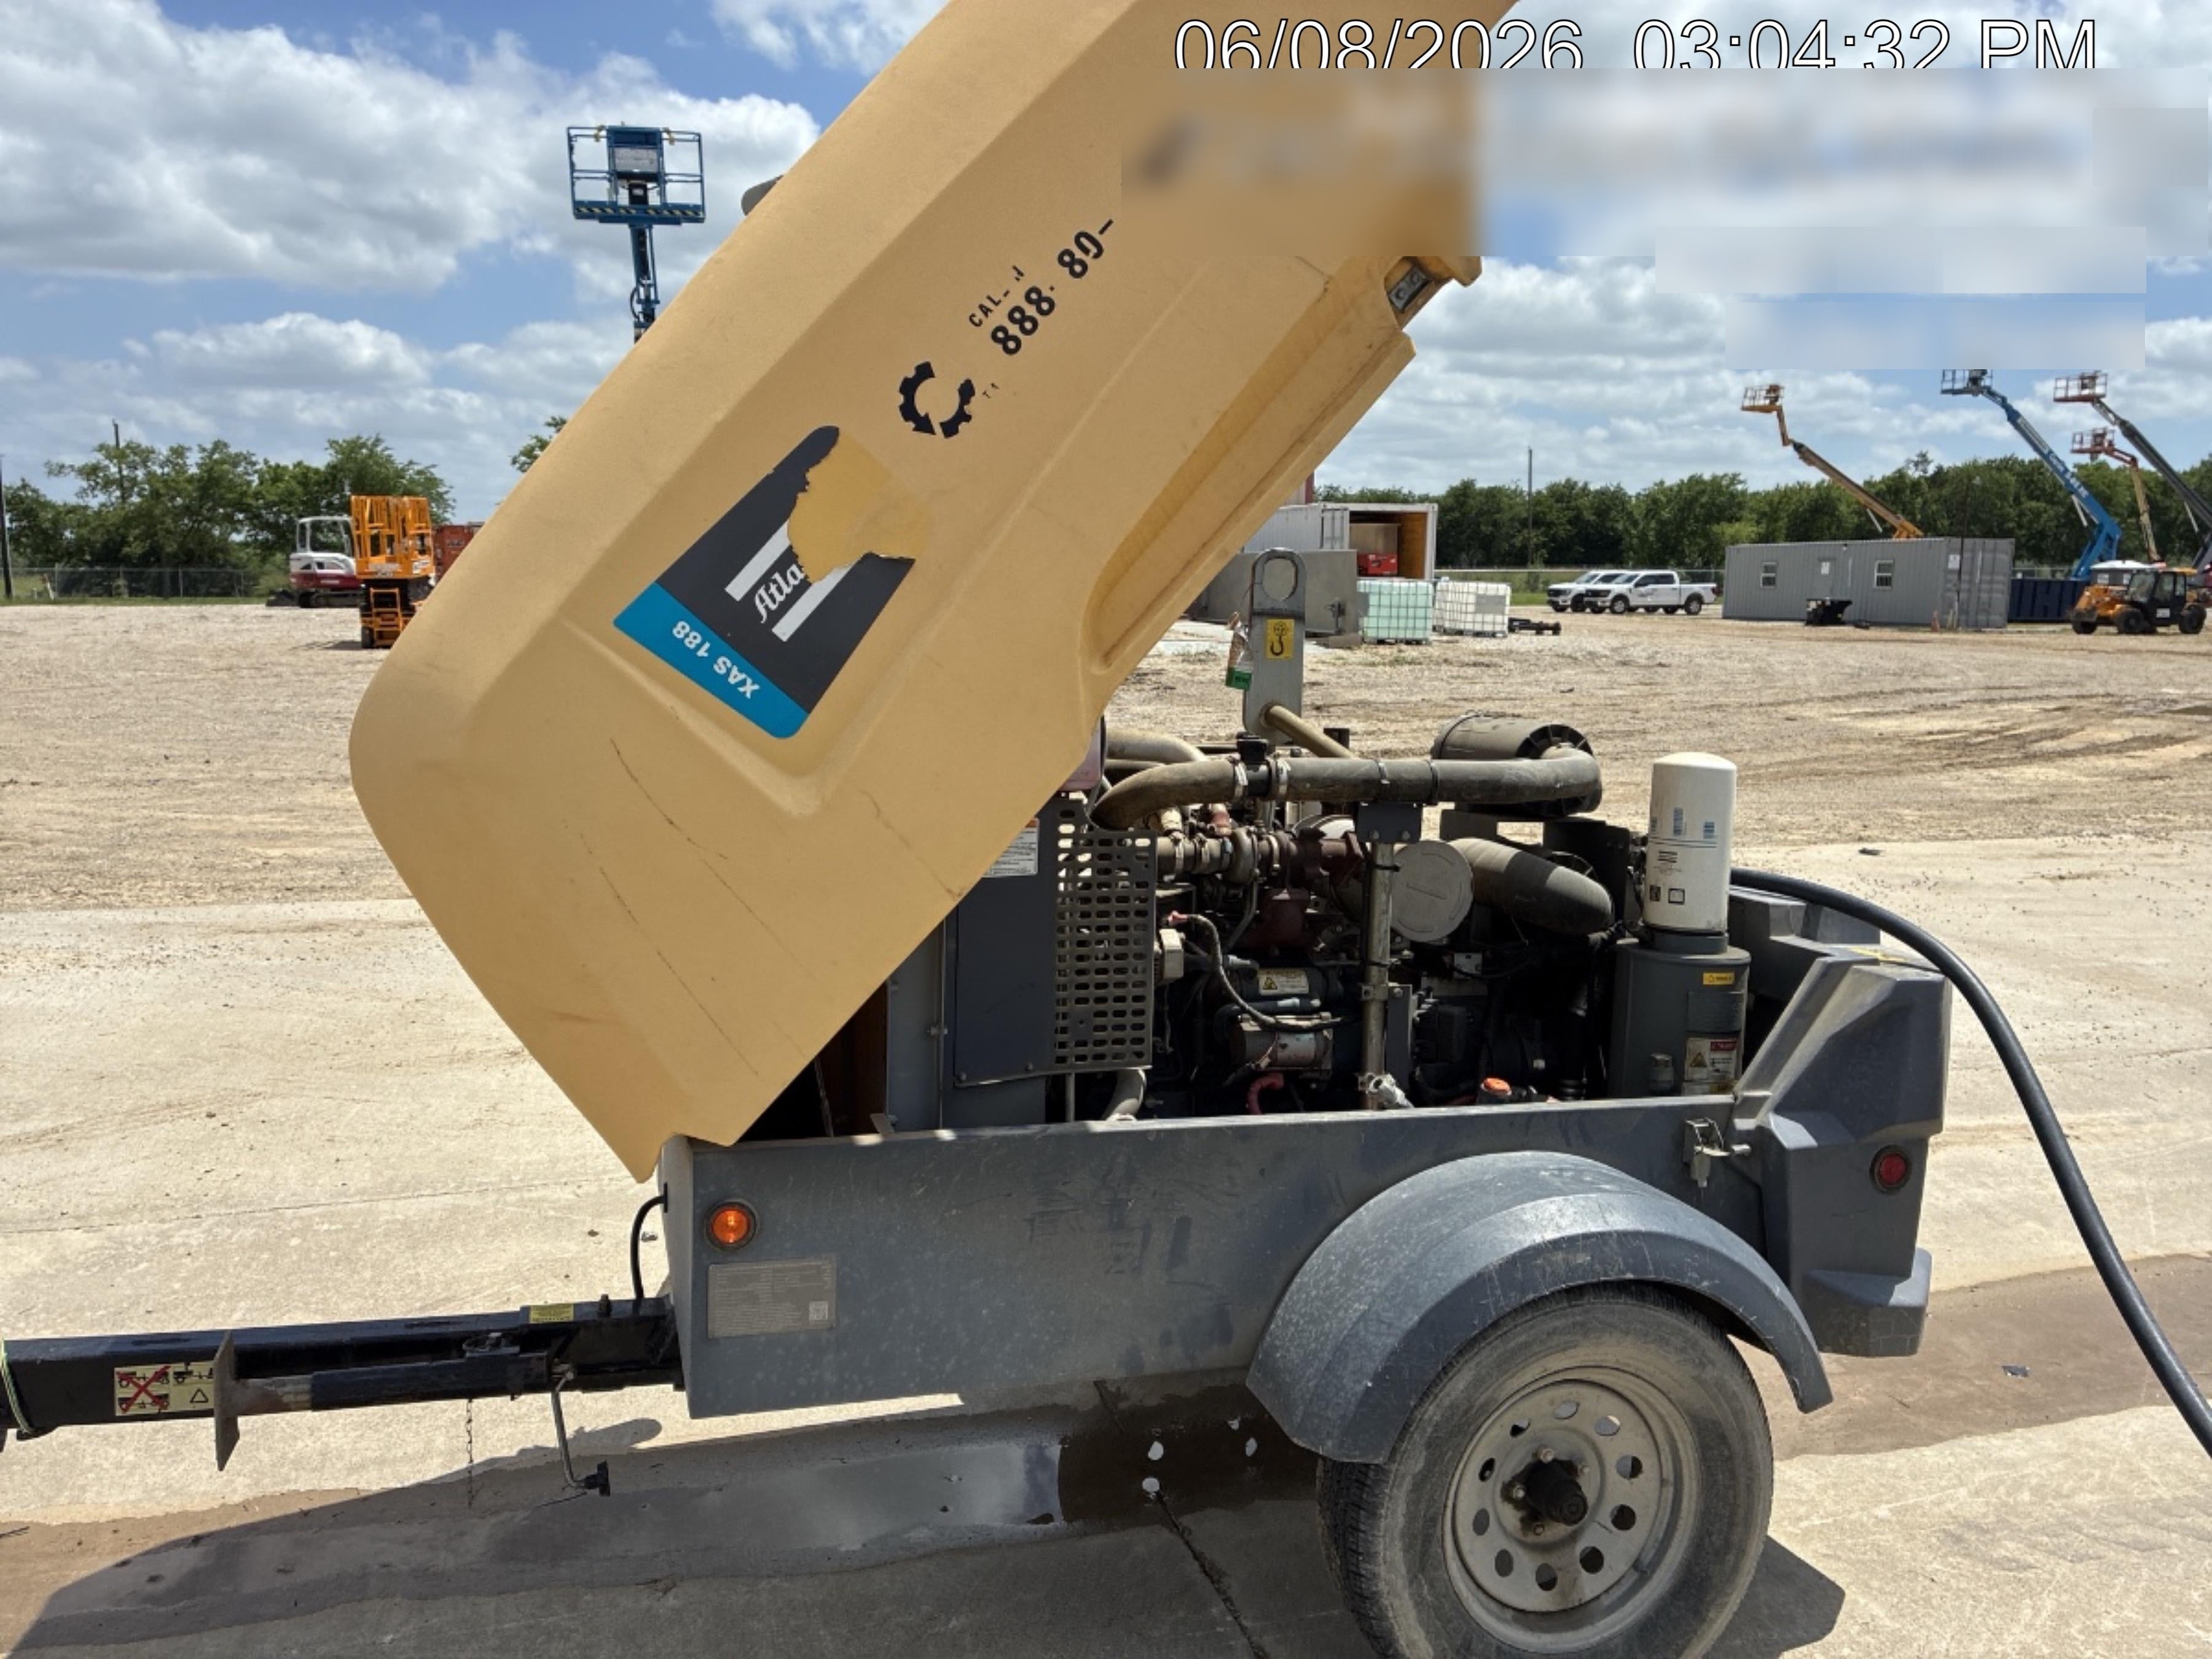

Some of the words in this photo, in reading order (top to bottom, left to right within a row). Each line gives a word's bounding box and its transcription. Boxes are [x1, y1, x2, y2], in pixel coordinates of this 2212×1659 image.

[968, 289, 1010, 327] CAL
[755, 563, 805, 624] Atla
[672, 621, 710, 657] 188
[713, 656, 761, 699] XAS
